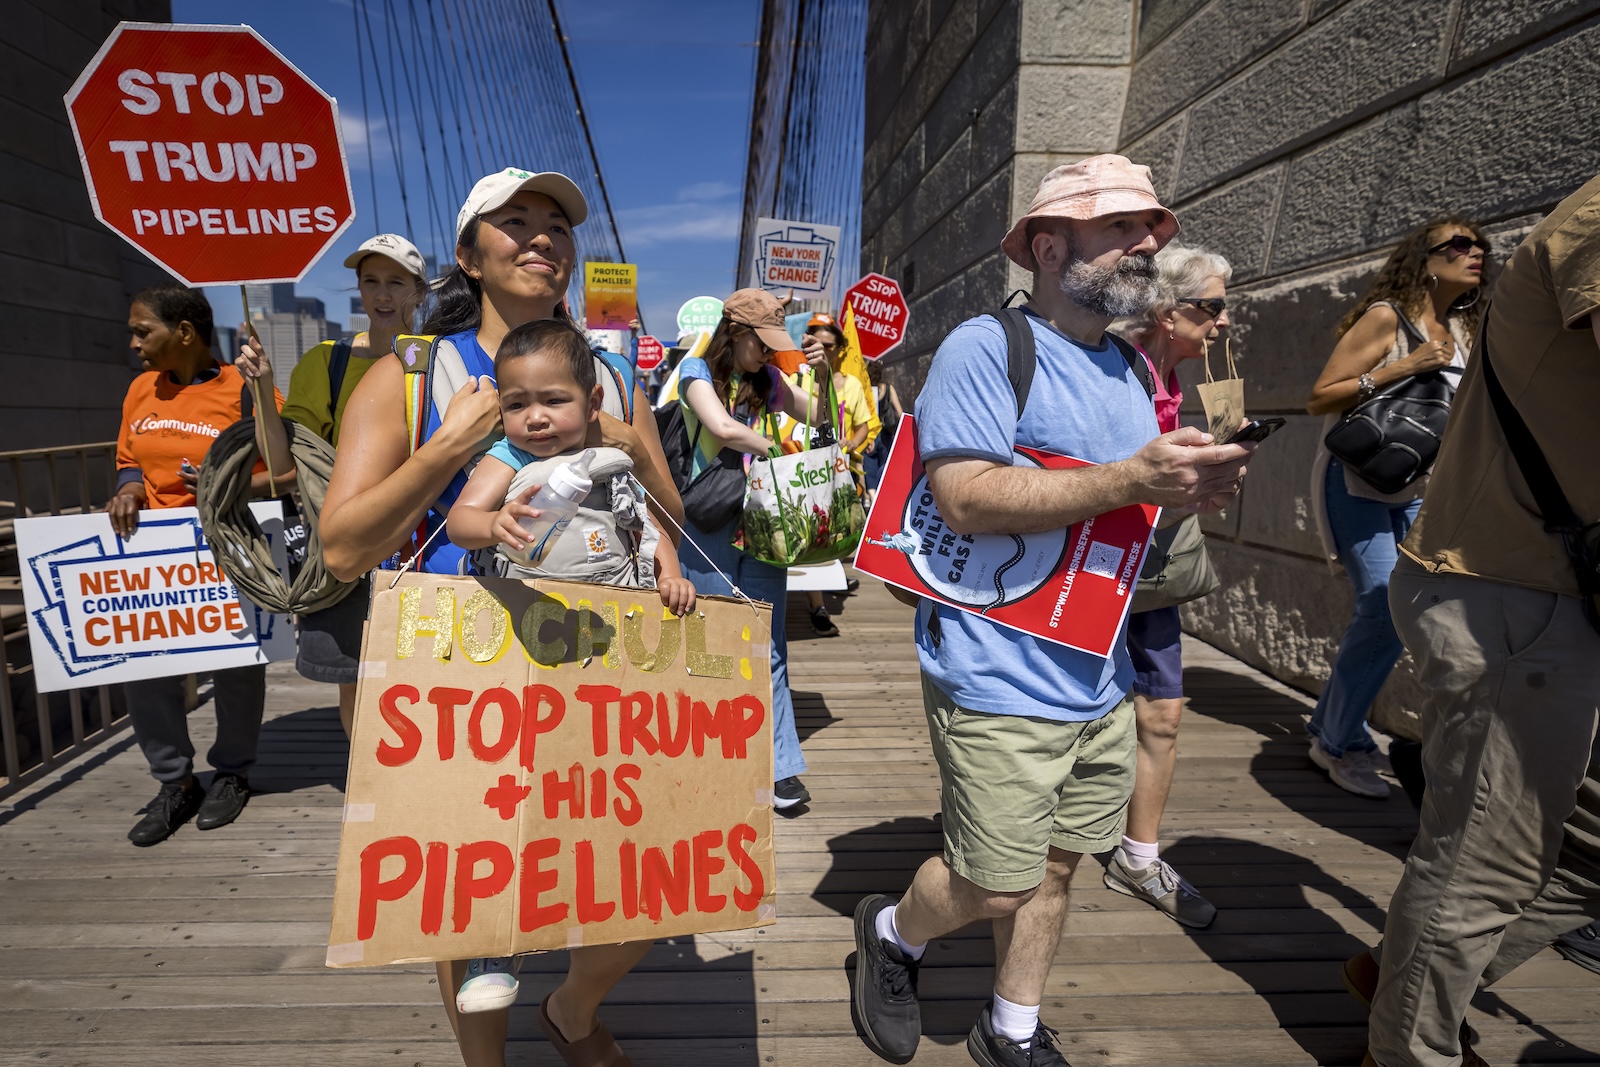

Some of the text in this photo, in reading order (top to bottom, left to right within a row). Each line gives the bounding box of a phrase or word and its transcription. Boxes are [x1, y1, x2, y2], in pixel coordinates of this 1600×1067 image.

[117, 68, 285, 117] STOP
[108, 140, 318, 183] TRUMP
[131, 205, 338, 236] PIPELINES
[770, 257, 817, 269] COMMUNITIES
[771, 245, 822, 261] NEW YORK
[591, 277, 632, 286] FAMILIES!
[594, 267, 630, 276] PROTECT
[768, 266, 819, 284] CHANGE
[866, 279, 897, 298] STOP
[691, 302, 714, 313] GO
[851, 291, 901, 323] TRUMP
[842, 309, 898, 341] PELINES
[637, 345, 661, 354] RUMP
[136, 412, 220, 438] Communitie
[947, 545, 971, 584] GAS
[1048, 517, 1096, 629] STOPWILLIAMSNESEPIPE
[1116, 541, 1141, 596] #STOPNESE
[79, 567, 151, 596] NEW
[82, 586, 228, 614] COMMUNITIES
[84, 602, 243, 647] CHANGE
[376, 683, 765, 772] STOP TRUMP
[542, 761, 643, 827] HIS
[357, 822, 765, 942] PIPELINES
